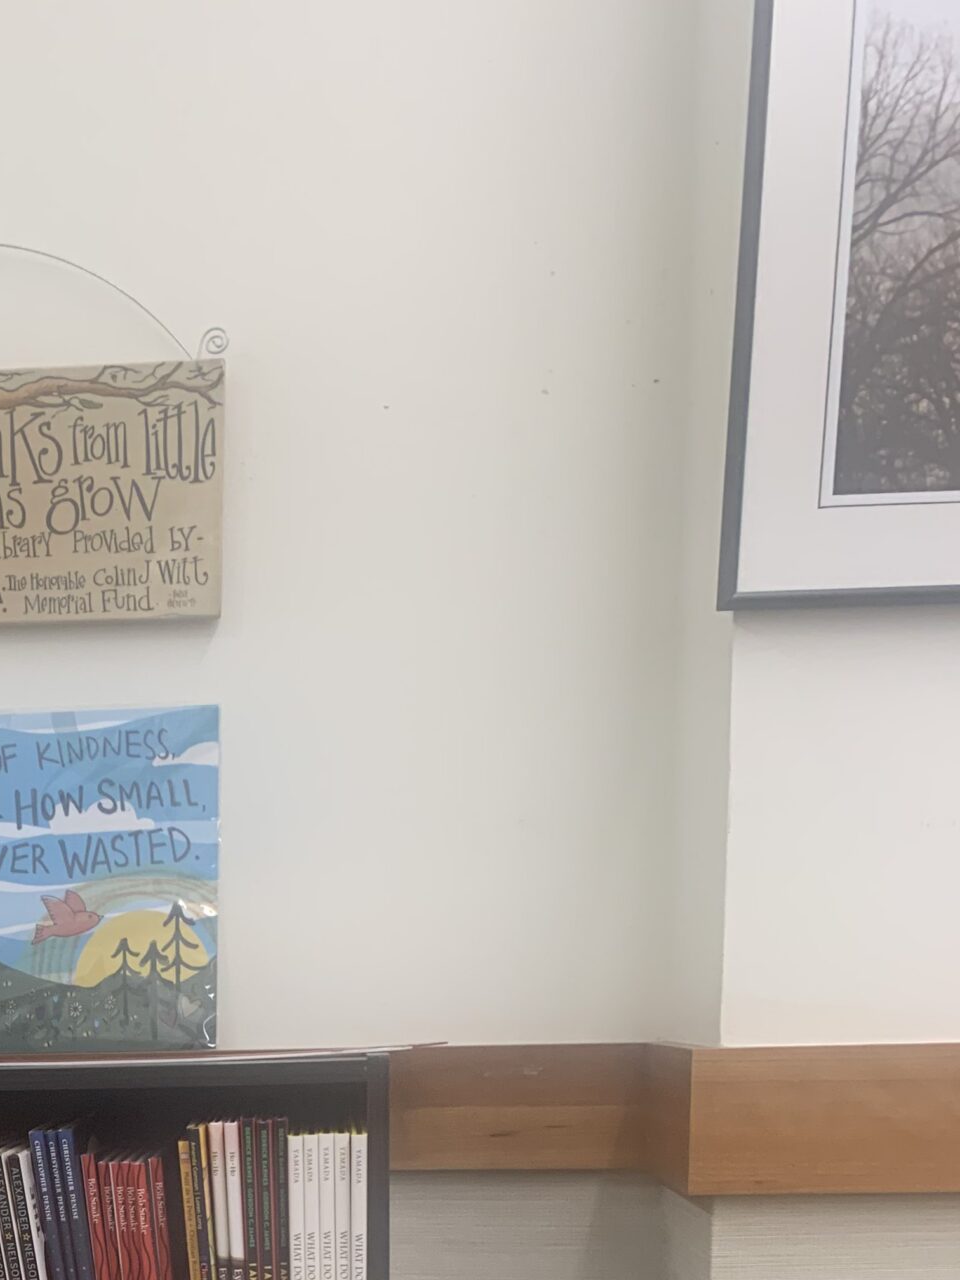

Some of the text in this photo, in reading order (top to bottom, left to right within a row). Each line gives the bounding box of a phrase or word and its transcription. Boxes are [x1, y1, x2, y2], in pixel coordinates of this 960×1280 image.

[68, 416, 130, 467] from
[139, 401, 216, 483] little
[46, 474, 165, 534] grow
[73, 526, 156, 553] Provided
[6, 575, 27, 591] The
[31, 571, 86, 590] Honorable
[93, 565, 137, 586] Colin
[139, 560, 150, 584] J
[157, 556, 209, 585] Witt
[23, 592, 94, 615] Memorial
[36, 727, 177, 771] KINDNESS,
[14, 786, 86, 830] HOW
[96, 778, 208, 818] SMALL,
[57, 827, 201, 879] WASTED.
[11, 1168, 29, 1230] ALEXANDER
[62, 1139, 79, 1219] CHRISTOPHER DENISE
[323, 1231, 331, 1260] WHAT
[323, 1264, 332, 1279] DO
